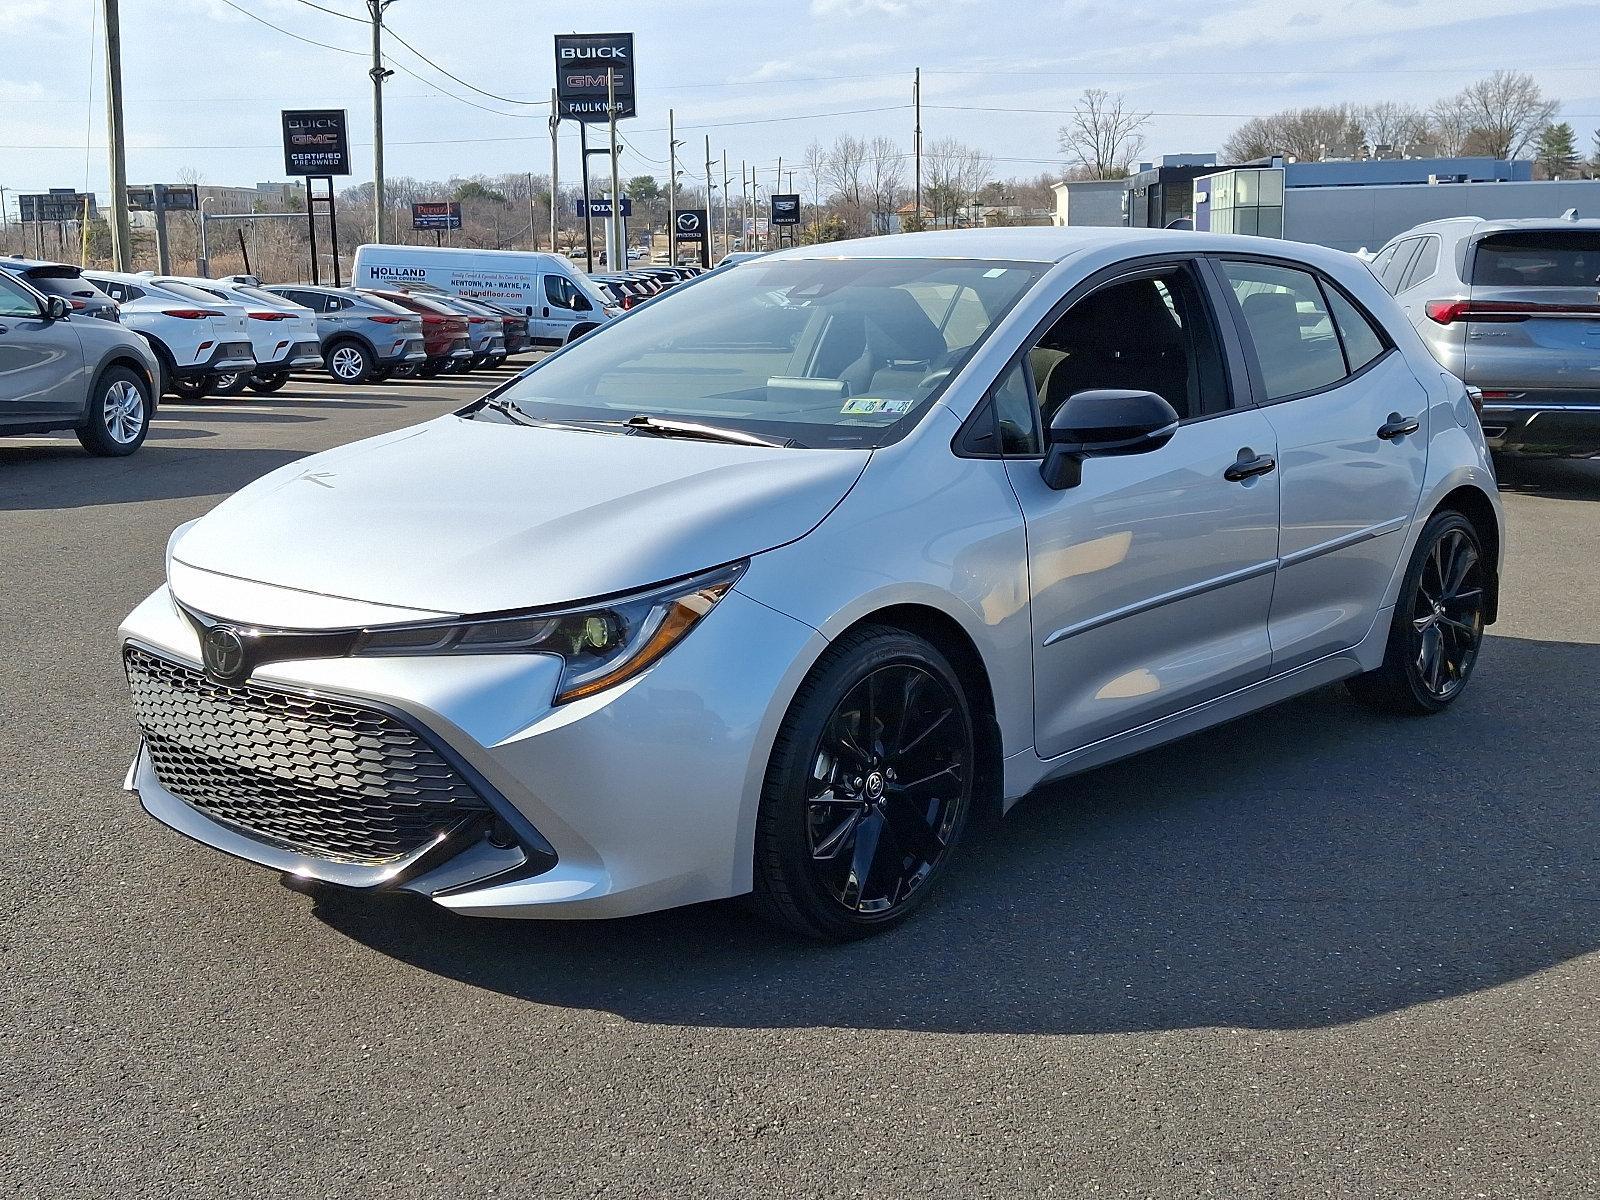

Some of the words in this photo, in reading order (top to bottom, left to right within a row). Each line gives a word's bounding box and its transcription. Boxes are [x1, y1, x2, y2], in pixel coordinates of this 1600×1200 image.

[561, 46, 627, 59] BUICK
[566, 74, 624, 88] GMC
[569, 102, 623, 113] FAULKNR
[288, 119, 338, 129] BUICK
[291, 133, 338, 145] GMC
[291, 152, 341, 160] CERTIFIED
[370, 267, 426, 279] HOLLAND
[450, 279, 484, 289] NEWTOWN,
[498, 282, 522, 290] WAYNE,
[522, 282, 531, 290] PA
[458, 289, 523, 299] hollandfloor.com
